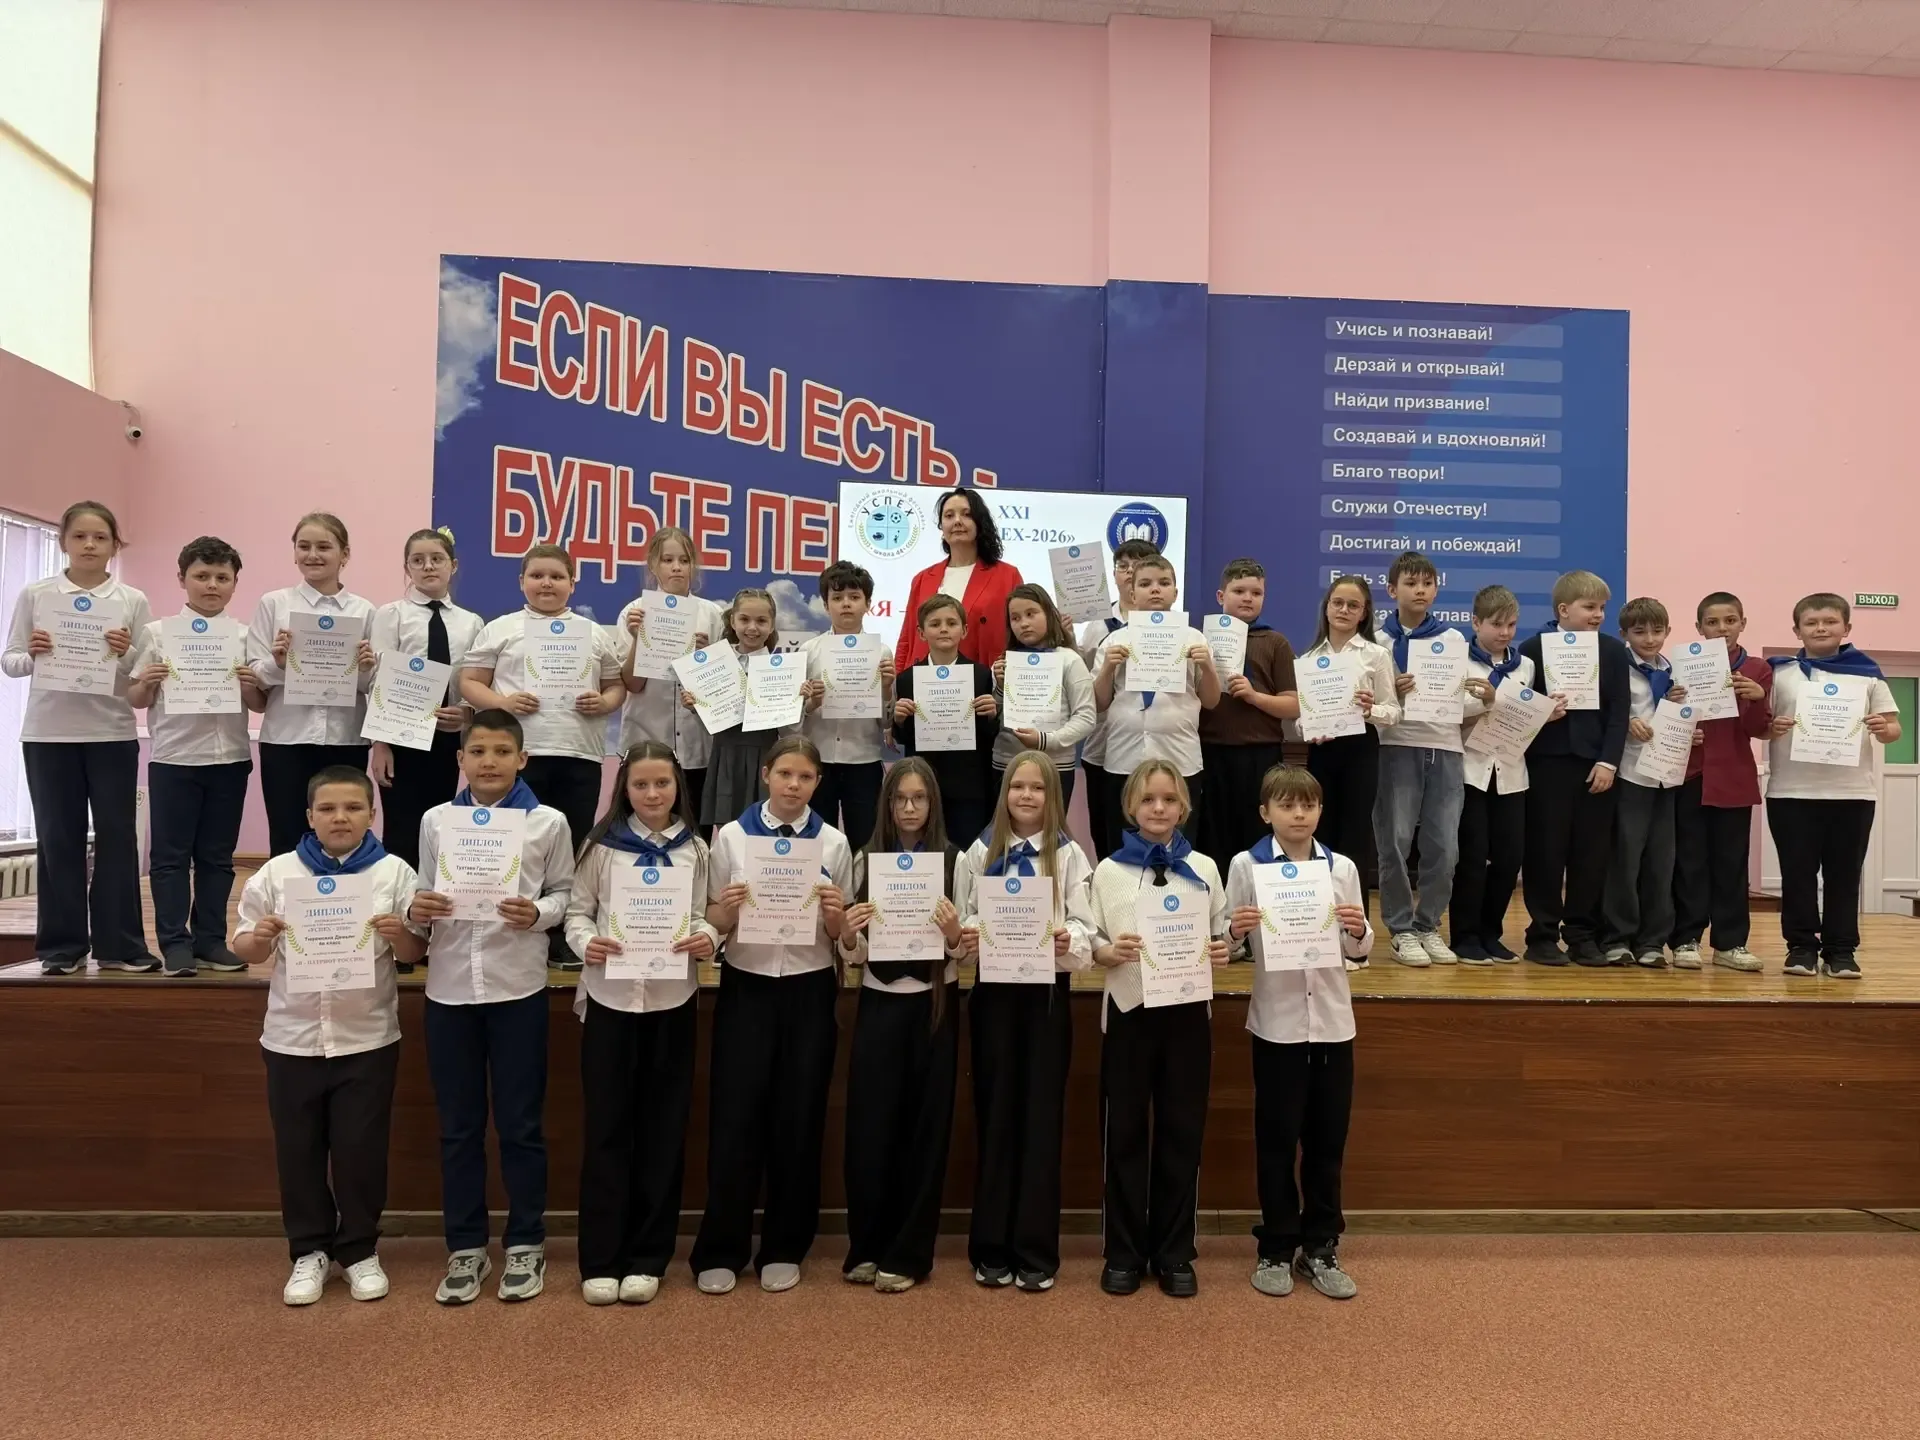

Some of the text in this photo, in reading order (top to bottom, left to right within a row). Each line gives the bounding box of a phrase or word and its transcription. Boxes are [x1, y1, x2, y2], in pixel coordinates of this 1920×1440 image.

[1336, 321, 1493, 341] Учись и познавай!
[1334, 357, 1504, 377] Дерзай и открывай!
[496, 272, 668, 423] ЕСЛИ
[683, 337, 787, 452] ВЫ
[801, 379, 960, 487] ЕСТЬ
[1334, 393, 1490, 411] Найди призвание!
[1333, 428, 1546, 448] Создавай и вдохновляй!
[1333, 464, 1444, 482] Благо твори!
[492, 444, 838, 583] БУДЬТЕ ПЕ
[861, 497, 914, 516] УСПЕХ
[1331, 500, 1487, 518] Служи Отечеству!
[1001, 528, 1075, 543] ЕХ-2026»
[1330, 535, 1521, 553] Достигай и побеждай!
[1330, 570, 1373, 584] Бь
[1859, 595, 1896, 605] ВЫХОД
[59, 621, 103, 632] ДИПЛОМ
[304, 639, 345, 647] ДИПЛОМ
[1684, 661, 1715, 672] ДИПЛОМ
[393, 678, 431, 693] ДИПЛОМ
[458, 839, 502, 847] ДИПЛОМ
[761, 867, 803, 876] ДИПЛОМ
[886, 883, 926, 891] ДИПЛОМ
[1275, 890, 1315, 899] ДИПЛОМ
[629, 898, 672, 906] ДИПЛОМ
[304, 907, 352, 918] ДИПЛОМ
[1155, 923, 1194, 934] ДИПЛОМ
